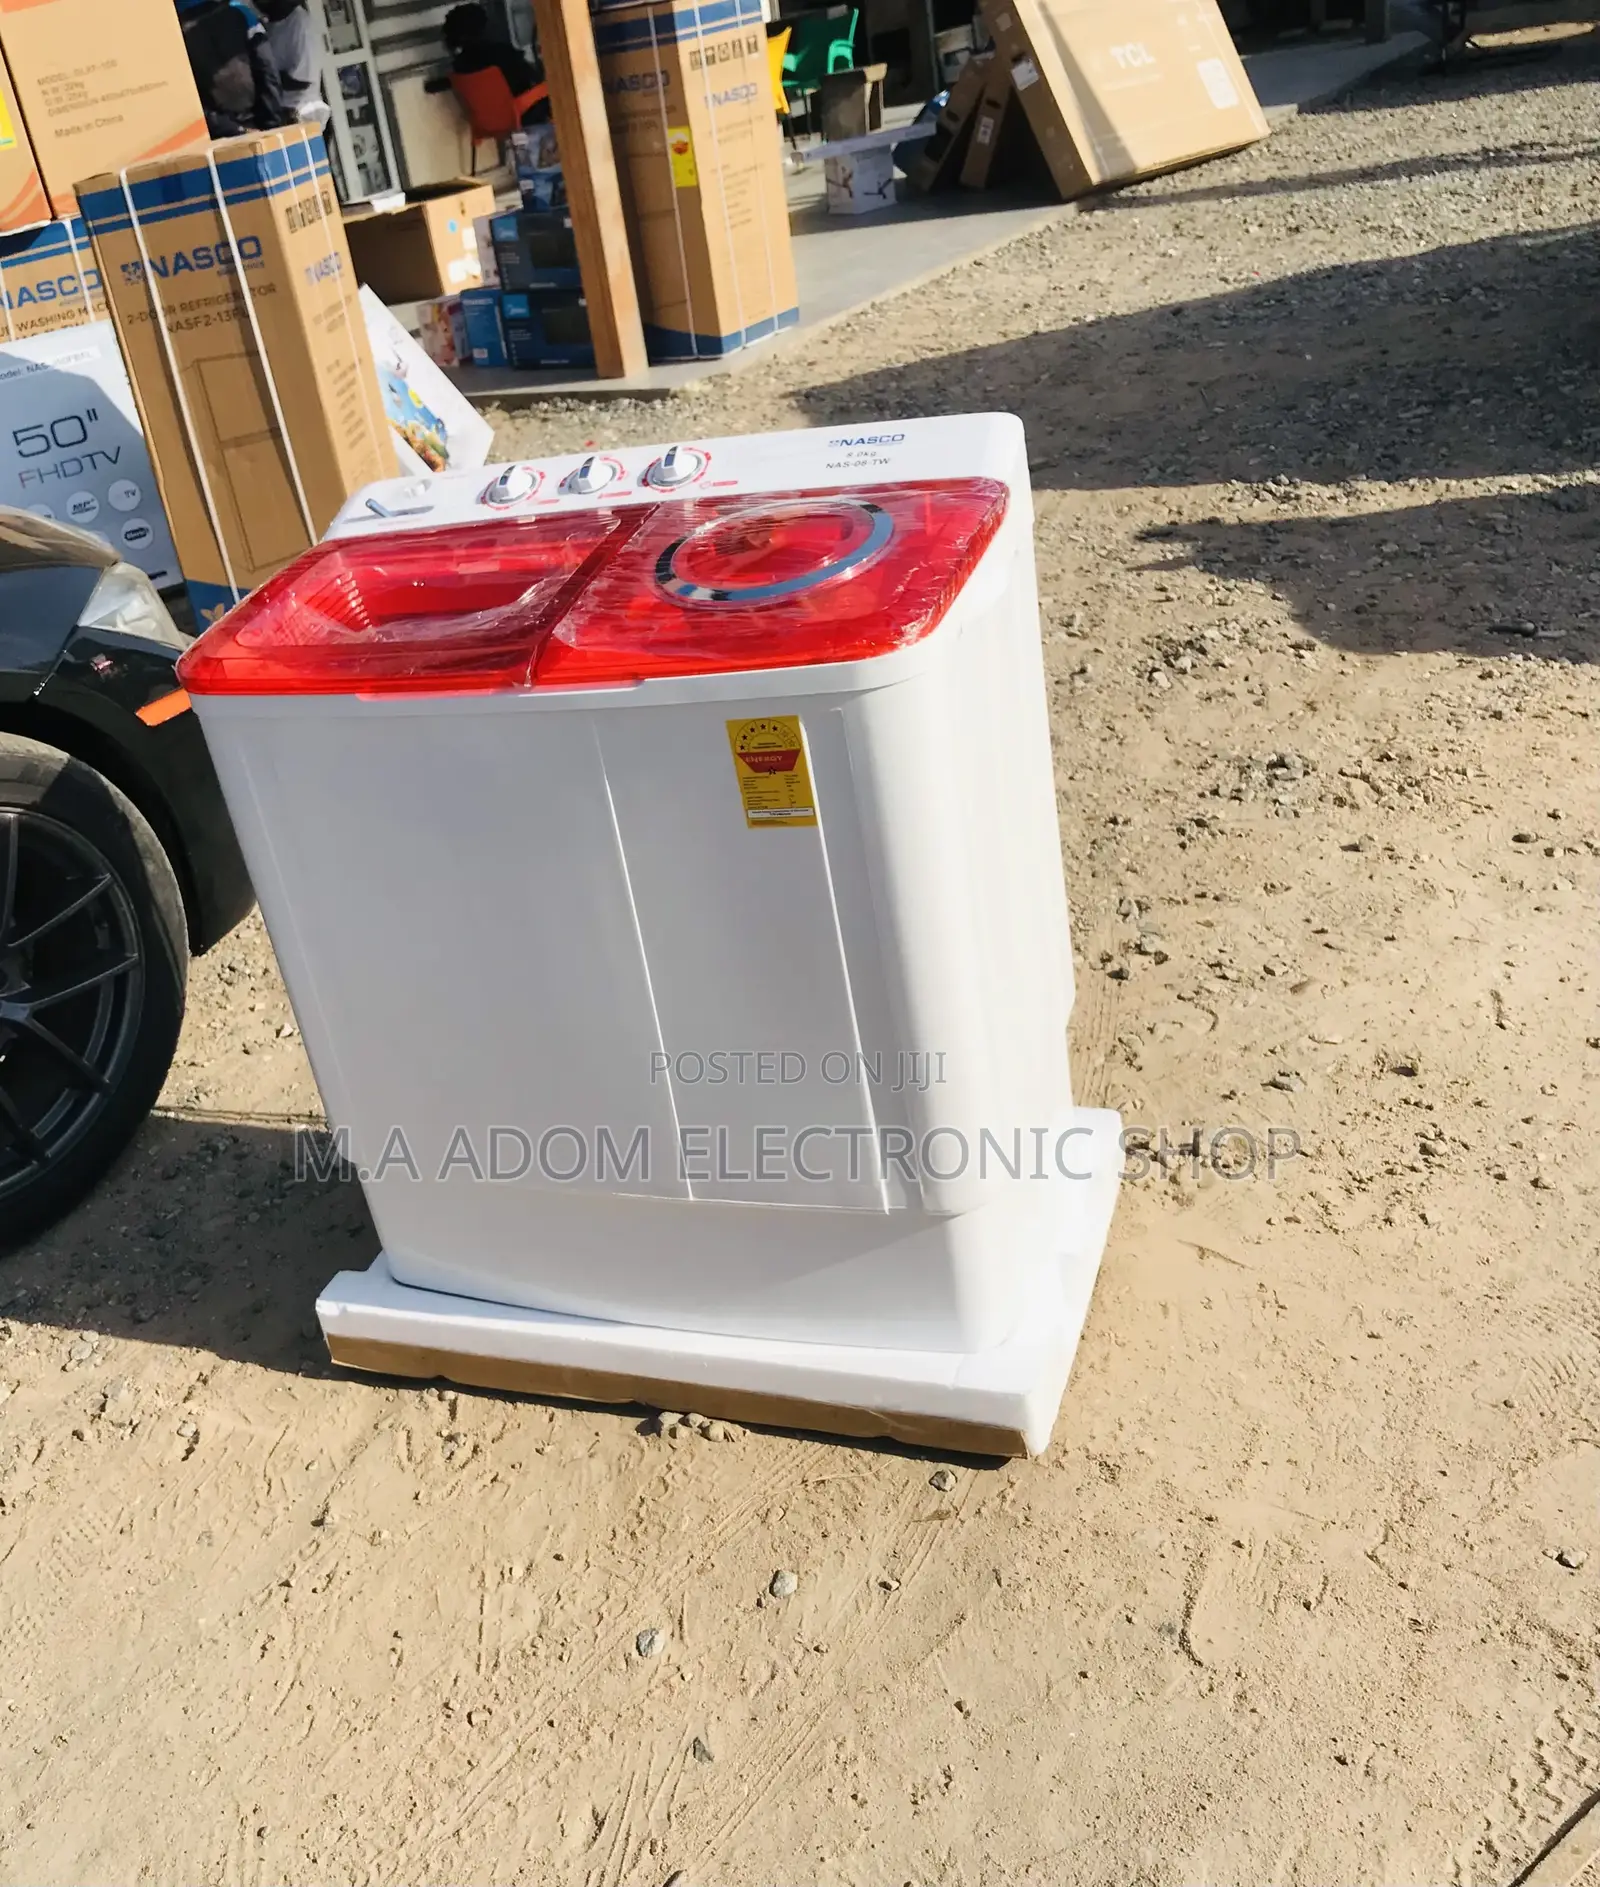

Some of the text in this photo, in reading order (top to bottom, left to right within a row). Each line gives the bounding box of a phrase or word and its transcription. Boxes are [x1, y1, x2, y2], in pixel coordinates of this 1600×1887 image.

[146, 235, 263, 279] NASCO
[16, 309, 76, 332] WASHING
[839, 433, 905, 447] NASCO
[18, 446, 121, 489] FHDTV
